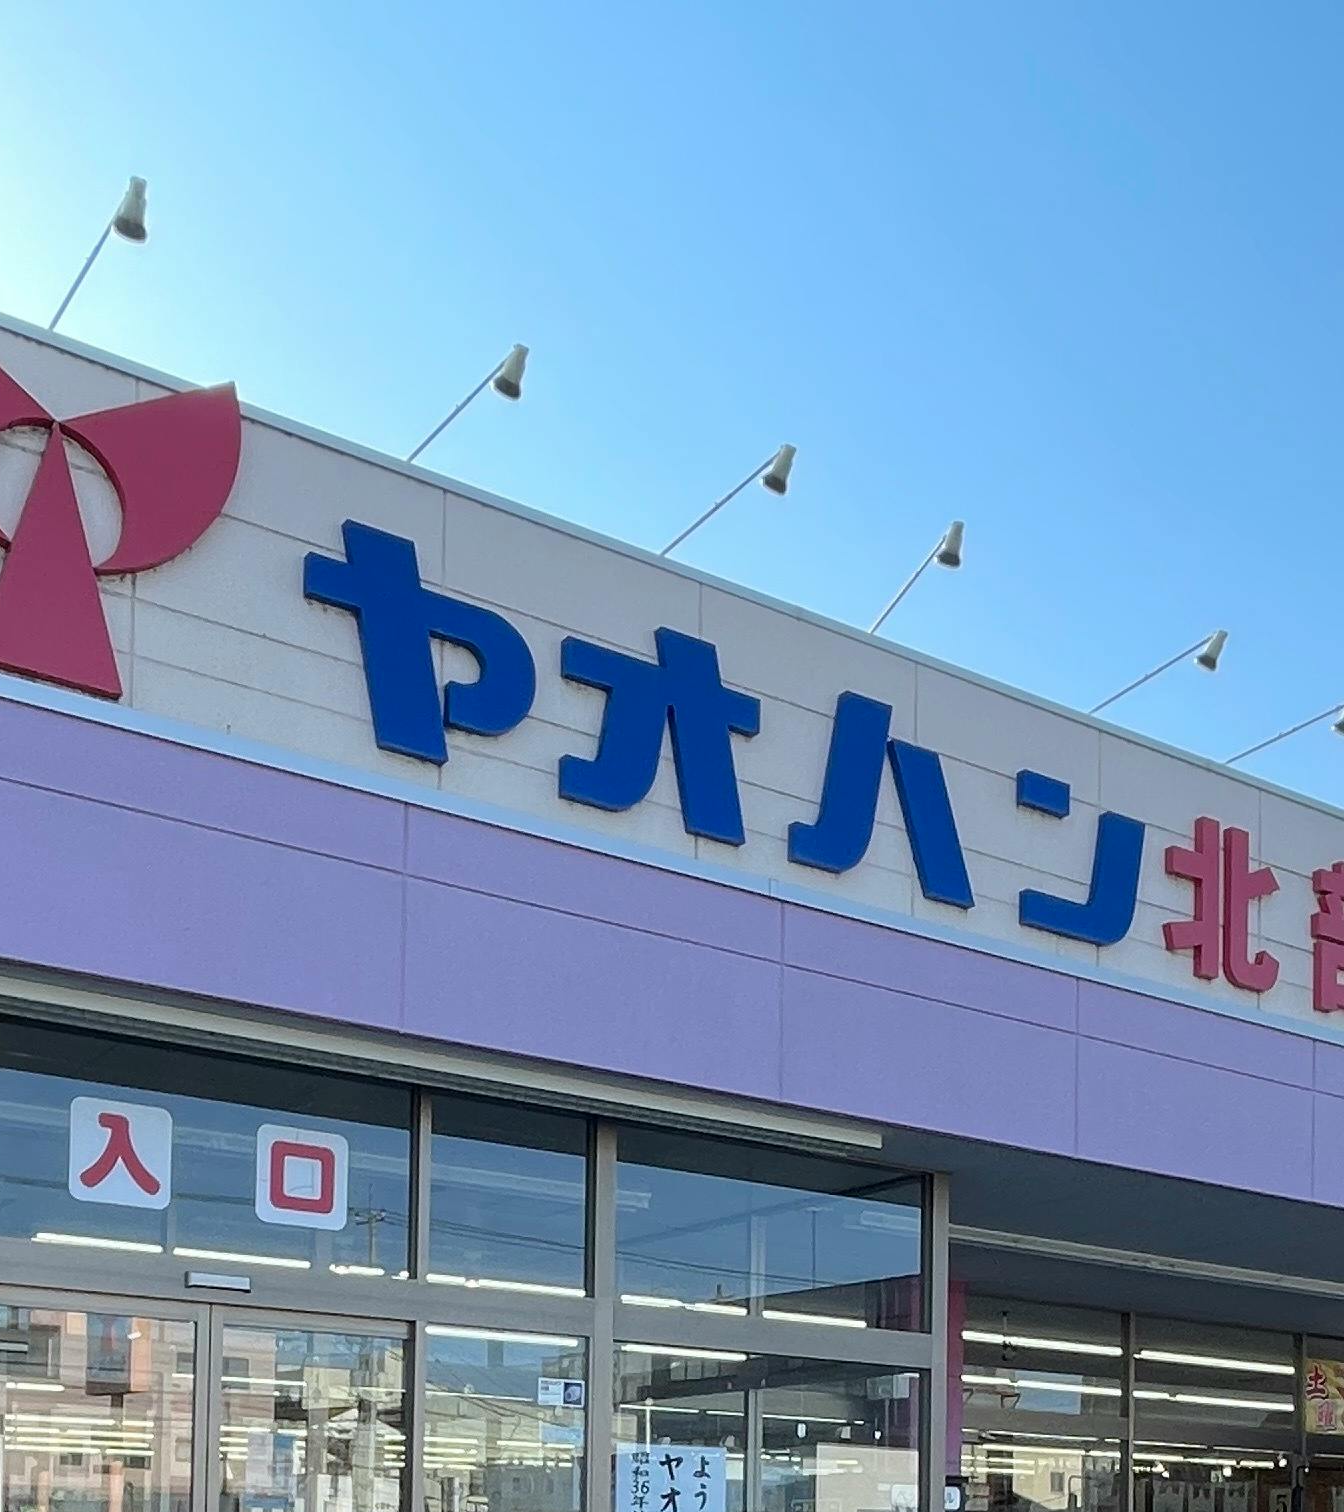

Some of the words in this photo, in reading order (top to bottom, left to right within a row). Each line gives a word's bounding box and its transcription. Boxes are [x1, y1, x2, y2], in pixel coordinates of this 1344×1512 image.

[304, 518, 1145, 947] ヤオハン
[80, 1112, 336, 1215] 入口
